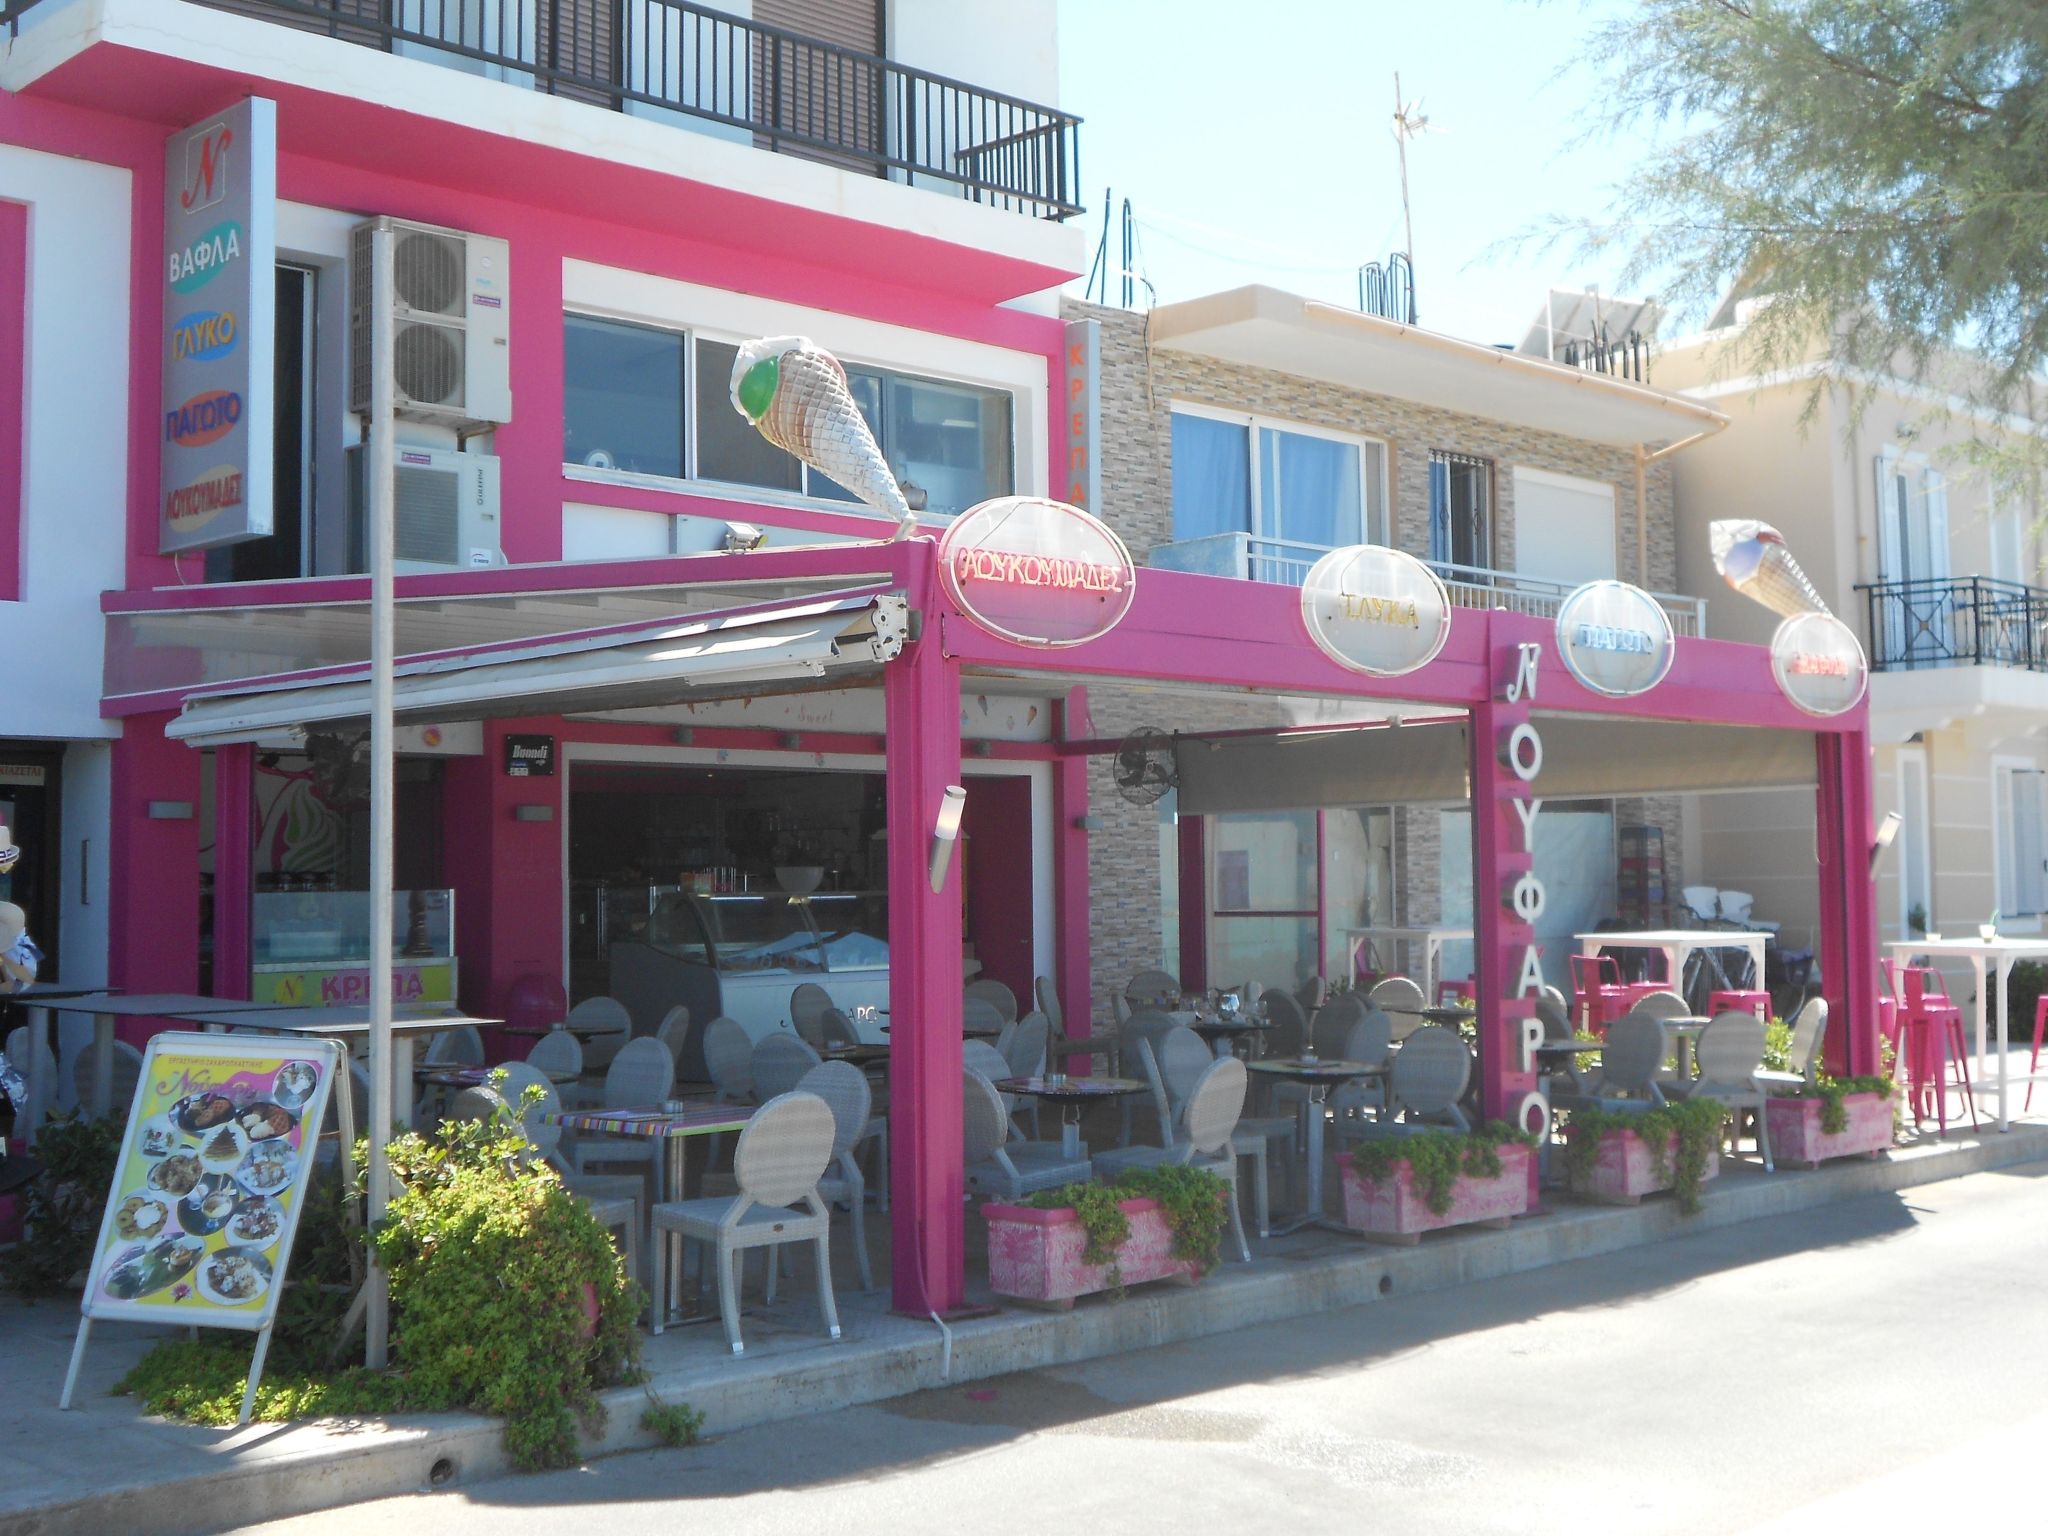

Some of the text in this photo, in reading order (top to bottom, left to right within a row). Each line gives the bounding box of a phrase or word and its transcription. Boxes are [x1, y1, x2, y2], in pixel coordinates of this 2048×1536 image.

[168, 227, 241, 283] ΒΑΦΛΑ
[172, 310, 236, 361] ΓΛΥΚΟ
[165, 391, 242, 443] ΠΑΓΩΤΟ
[1068, 343, 1088, 504] ΚΡΕΠΑ
[164, 472, 242, 521] ΛΟΥΚΟΥΜΑΔΕΣ
[960, 548, 1123, 593] ΛΟΥΚΟΥΜΑΔΕΣ
[1506, 642, 1550, 1148] ΝΟΥΦΑΡΟ
